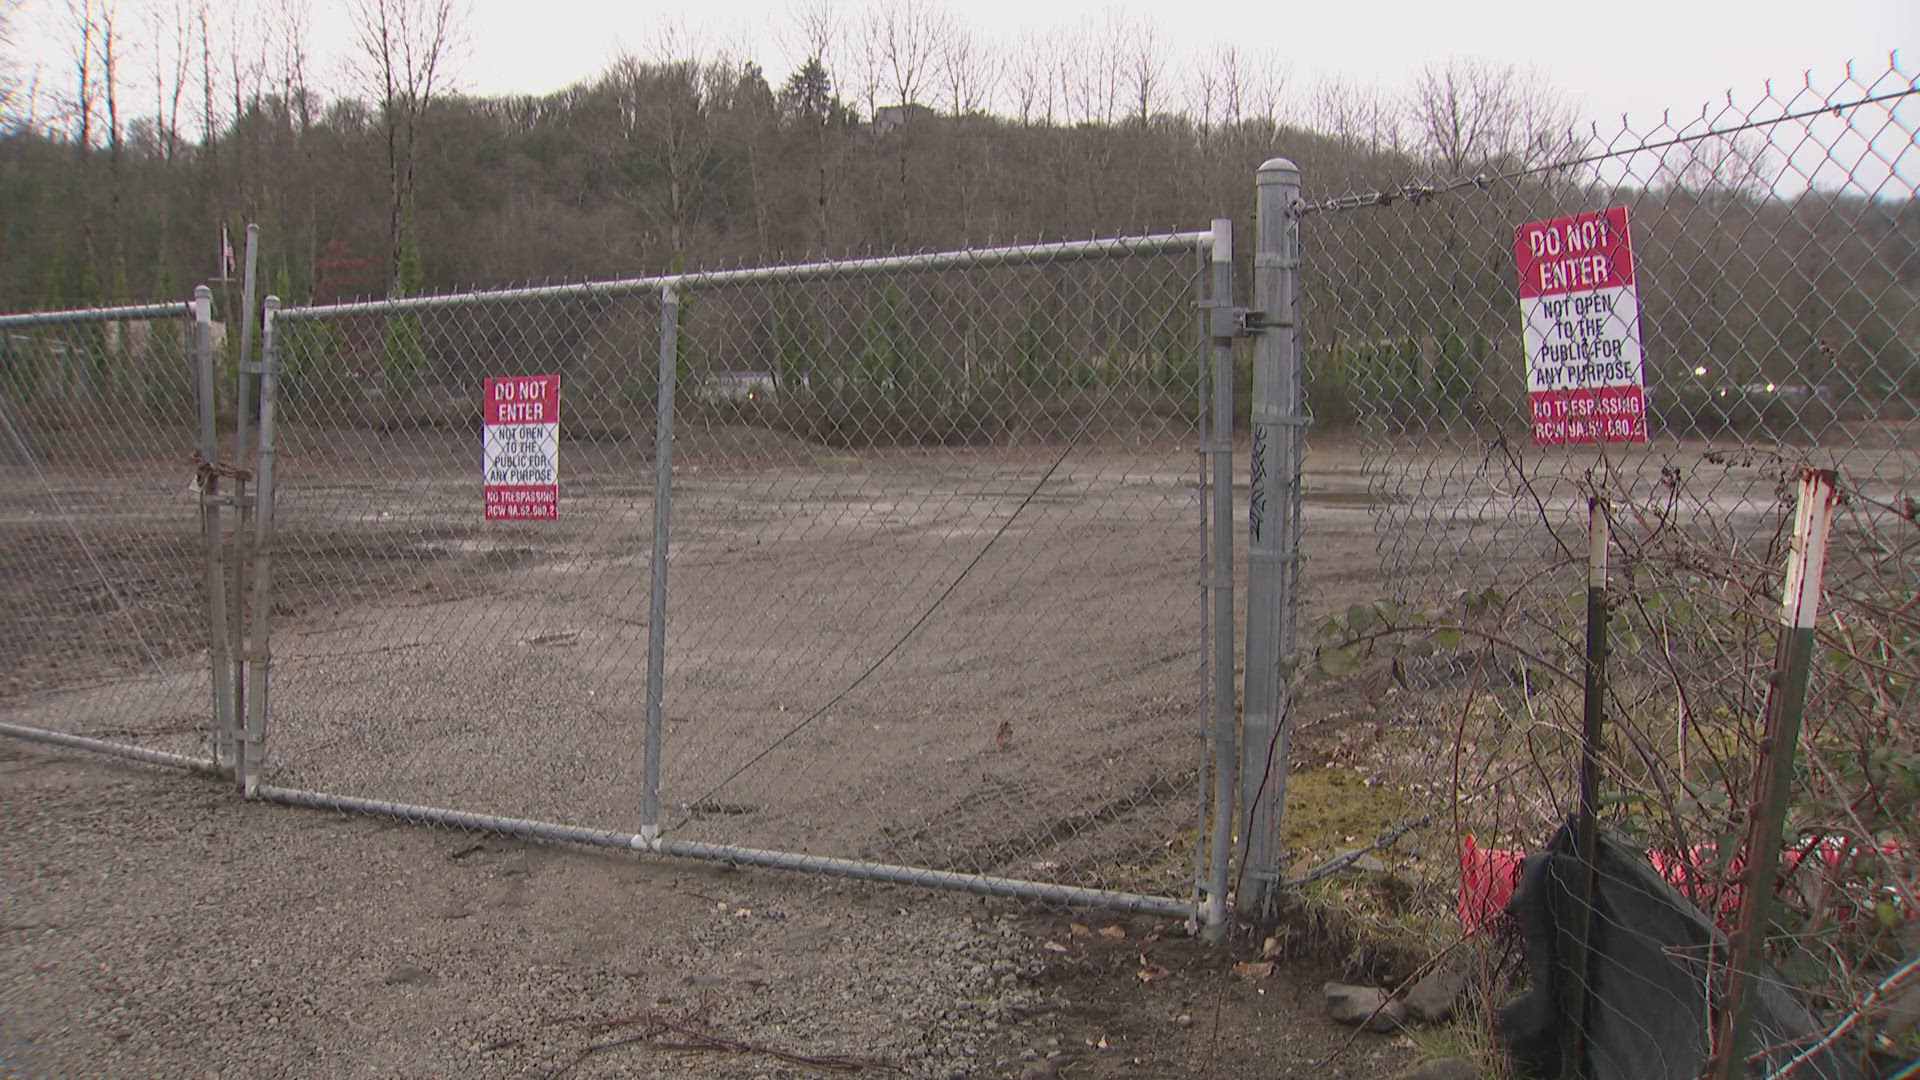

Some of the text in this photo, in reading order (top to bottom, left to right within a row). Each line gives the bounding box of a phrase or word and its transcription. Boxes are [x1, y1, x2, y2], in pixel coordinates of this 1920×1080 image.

[1530, 220, 1610, 257] DO NOT
[1540, 254, 1609, 290] ENTER
[1543, 294, 1611, 319] NOT OPEN
[1557, 318, 1604, 340] TO THE
[1541, 339, 1622, 363] PUBLIC FOR
[1536, 362, 1632, 386] ANY PURPOSE
[495, 380, 547, 400] DO NOT
[499, 402, 543, 422] ENTER
[1534, 401, 1551, 418] NO
[499, 427, 543, 440] NOT OPEN
[1536, 421, 1564, 439] RCW
[506, 441, 537, 454] TO THE
[495, 455, 547, 468] PUBLIC FOR
[490, 469, 552, 481] ANY PURPOSE
[487, 491, 555, 502] NO TRESPASSING
[487, 505, 506, 516] RCW
